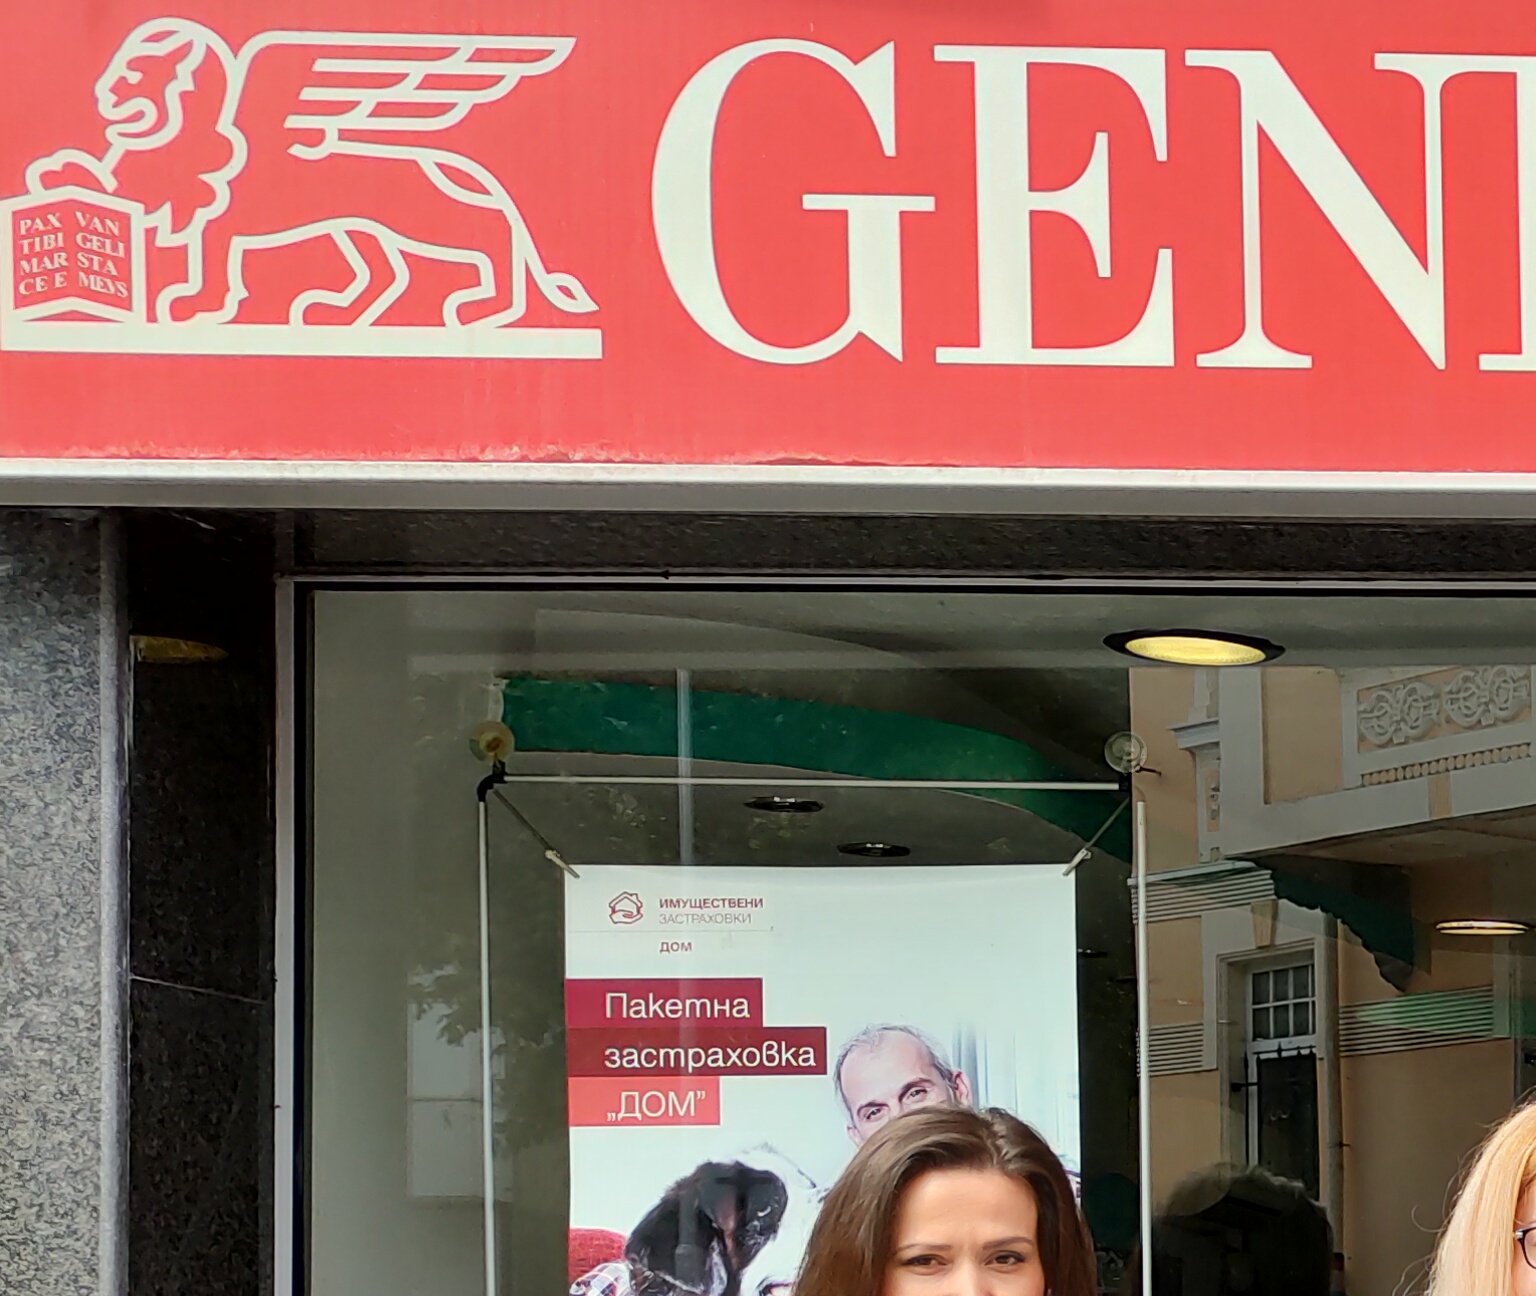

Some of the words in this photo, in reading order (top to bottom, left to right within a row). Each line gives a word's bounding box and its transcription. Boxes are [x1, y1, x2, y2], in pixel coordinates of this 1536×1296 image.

[20, 212, 62, 235] PAX
[75, 210, 119, 237] VAN
[19, 232, 64, 254] TIBI
[76, 232, 125, 258] GELI
[20, 252, 68, 275] MAR
[77, 252, 118, 276] STA
[659, 898, 763, 910] ИМУЩЕСТВЕНИ
[659, 913, 752, 924] ЗАСТРАХОВКИ
[660, 942, 692, 953] ДОМ
[605, 992, 749, 1019] Пакетна
[604, 1041, 816, 1074] застраховка
